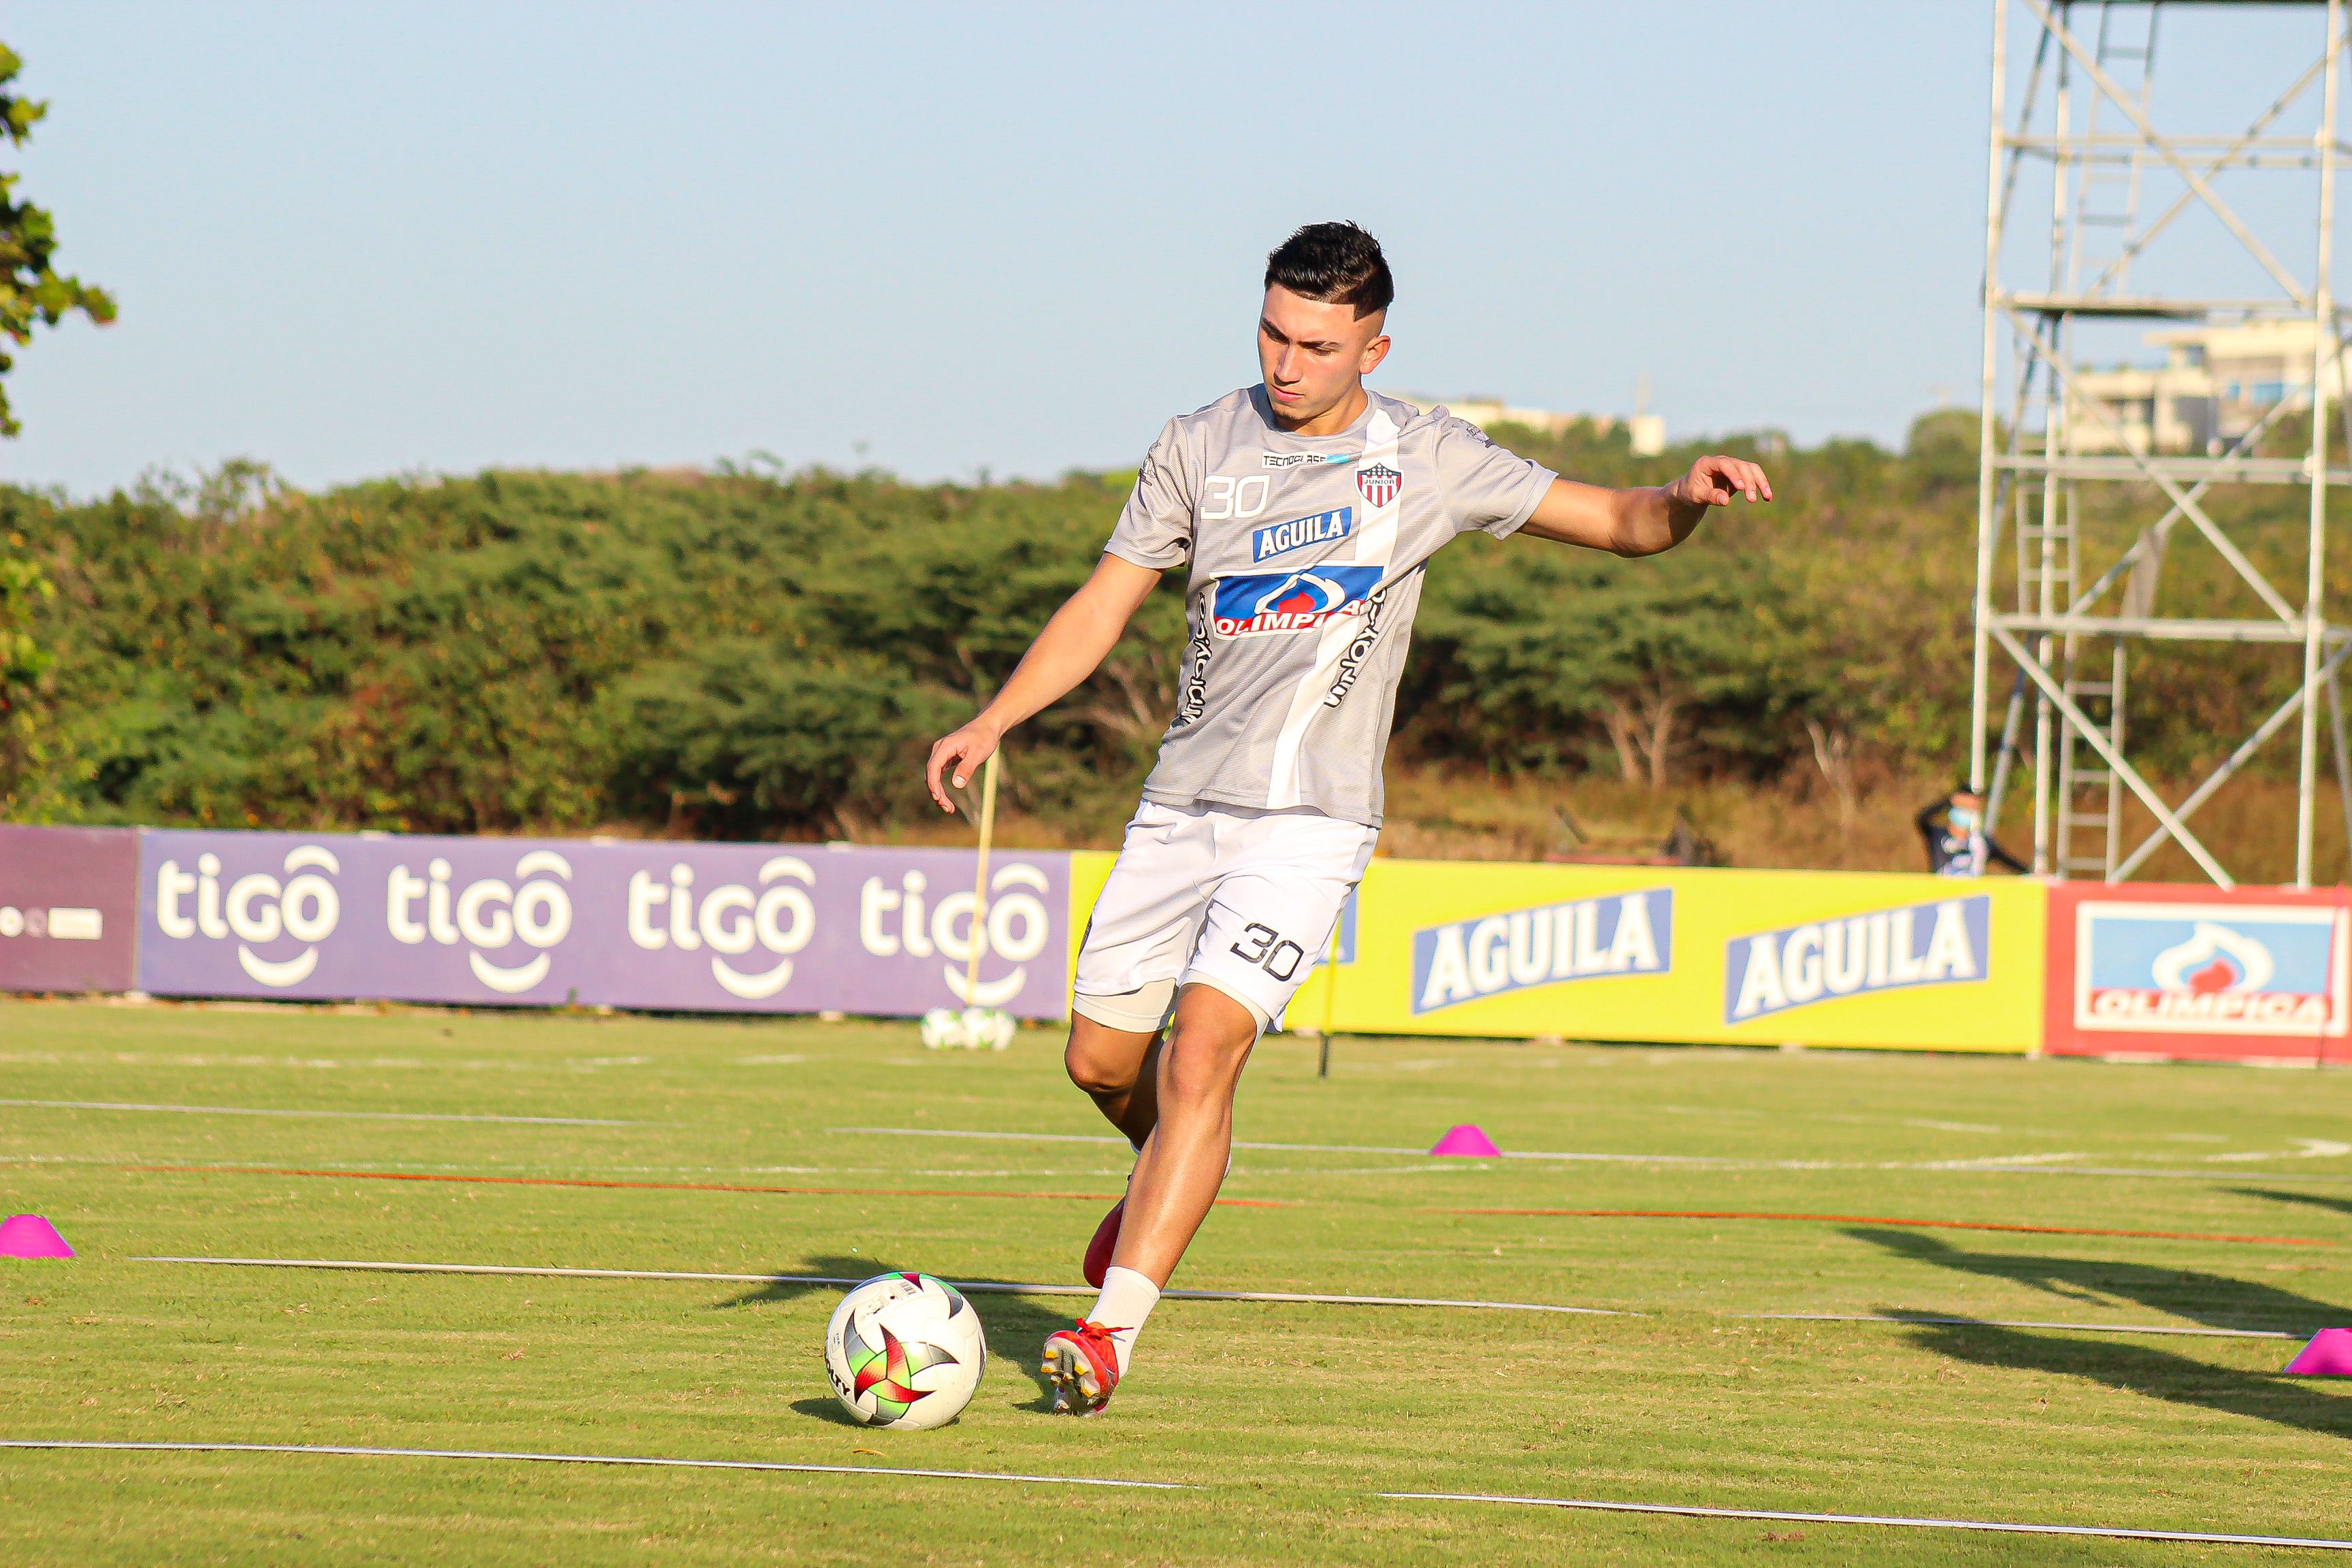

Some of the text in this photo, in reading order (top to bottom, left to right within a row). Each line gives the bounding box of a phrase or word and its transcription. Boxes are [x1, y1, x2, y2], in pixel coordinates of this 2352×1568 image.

[1200, 474, 1271, 521] 30
[1258, 510, 1344, 559] AGUILA
[1216, 599, 1362, 635] OLIMPIA
[1230, 922, 1305, 982] 30
[1419, 892, 1661, 1009] AGUILA
[1732, 900, 1978, 1019] AGUILA
